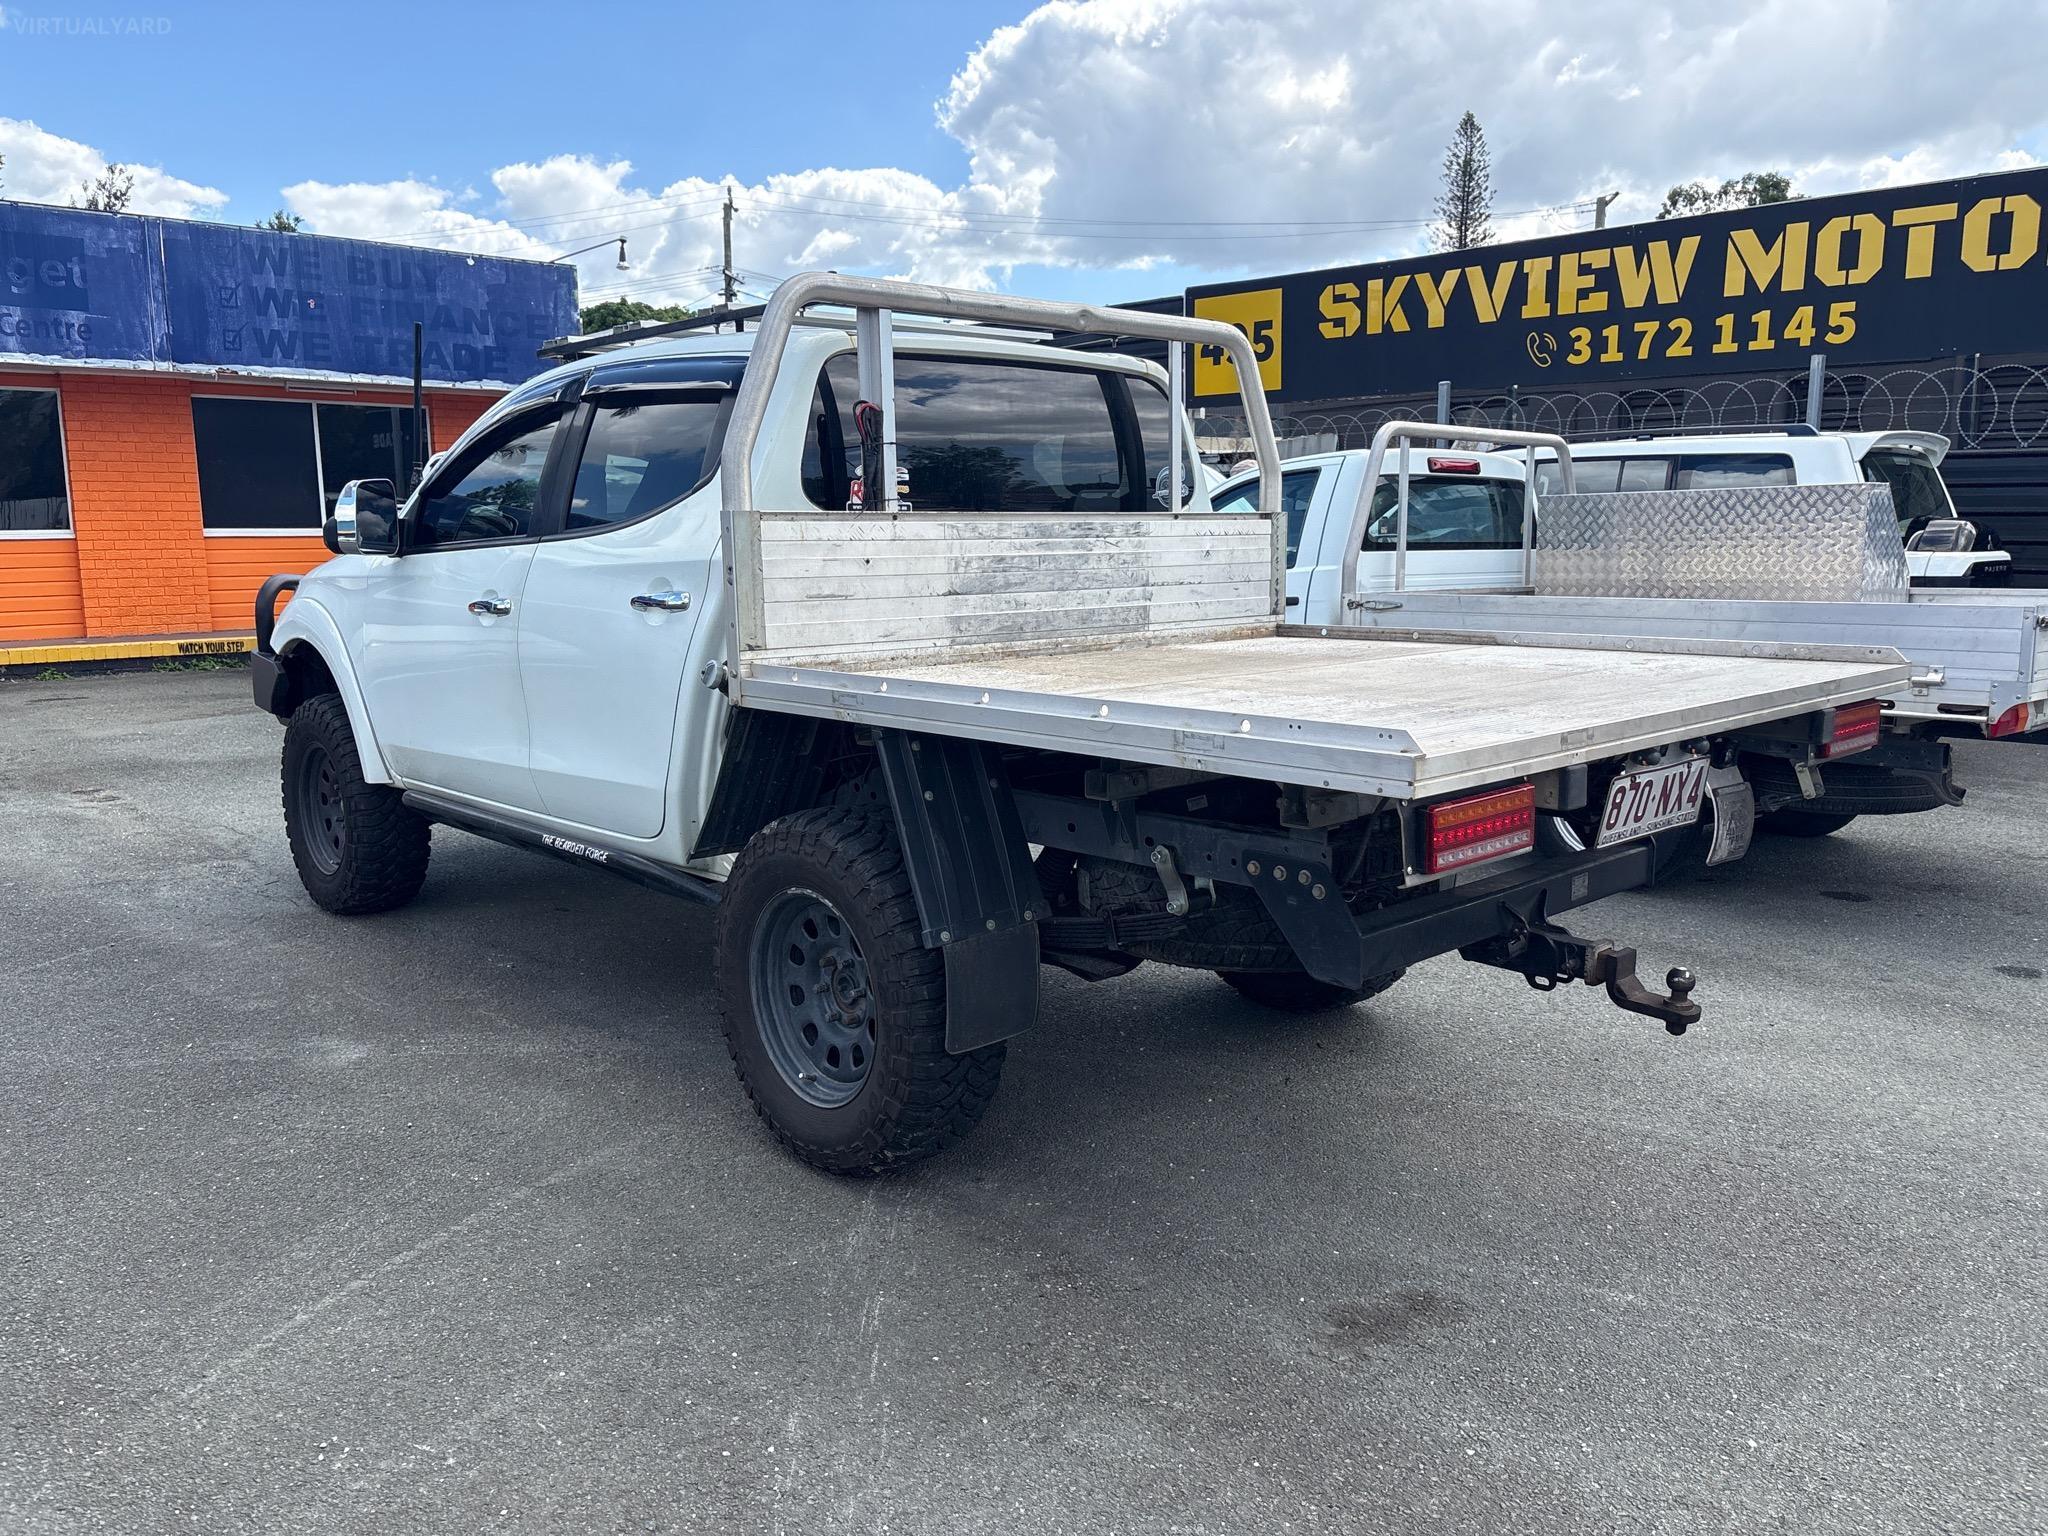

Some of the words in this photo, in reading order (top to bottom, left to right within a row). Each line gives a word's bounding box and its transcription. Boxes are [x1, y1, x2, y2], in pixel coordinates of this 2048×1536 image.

[247, 243, 322, 281] WE
[347, 255, 443, 293] BUY
[1318, 235, 1702, 339] SKYVIEW
[1723, 194, 2048, 298] MOTO
[0, 312, 93, 342] Centre
[251, 286, 327, 321] WE
[351, 295, 552, 343] FINANCE
[1566, 317, 1693, 365] 3172
[1711, 301, 1857, 354] 1145
[253, 328, 332, 362] WE
[354, 335, 510, 376] TRADE
[1200, 319, 1275, 366] 45
[178, 643, 204, 653] WATCH
[205, 642, 225, 653] YOUR
[226, 641, 244, 652] STEP
[542, 834, 555, 846] THE
[555, 838, 585, 855] BEARDED
[585, 848, 609, 862] FORGE
